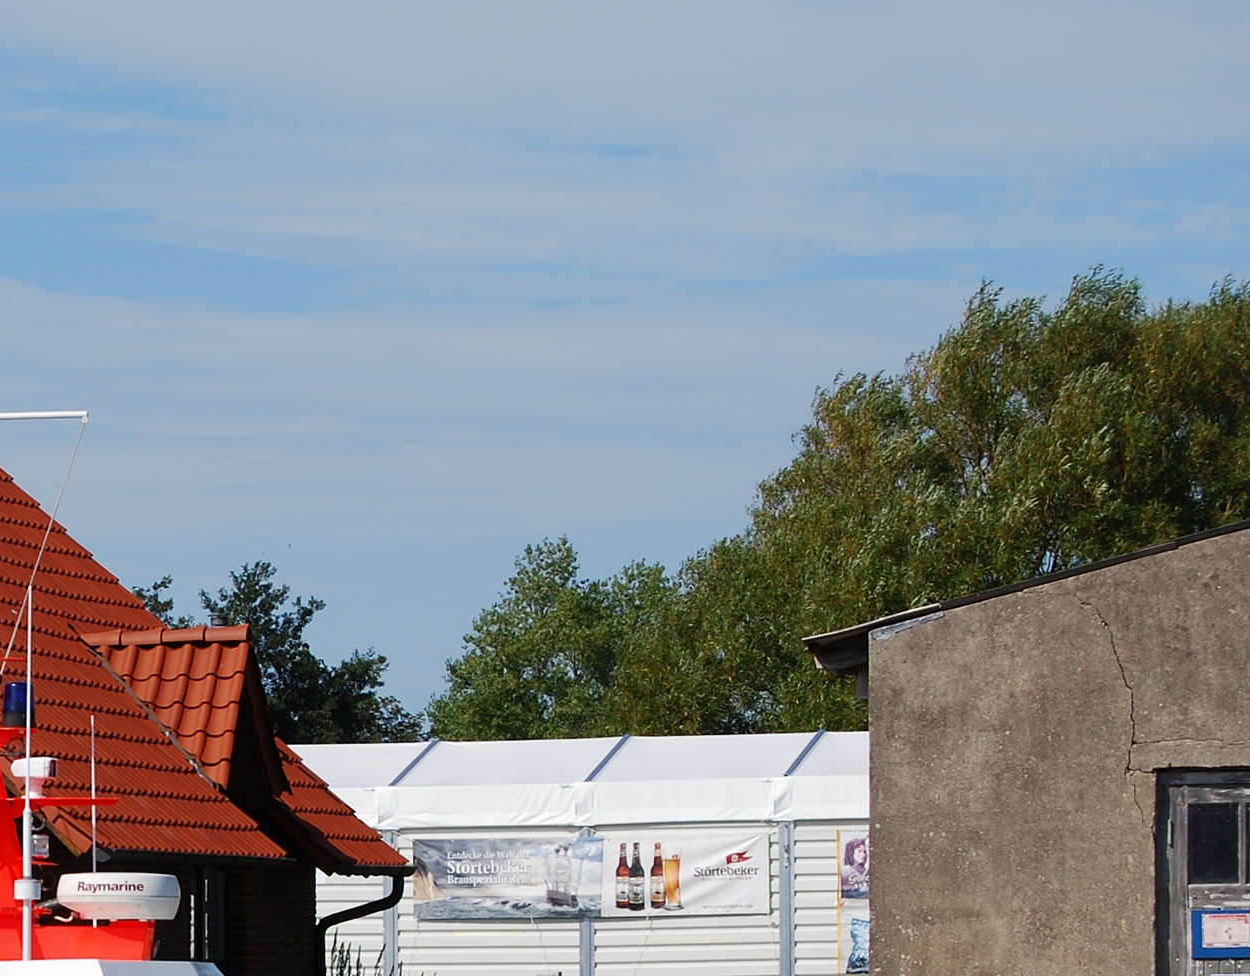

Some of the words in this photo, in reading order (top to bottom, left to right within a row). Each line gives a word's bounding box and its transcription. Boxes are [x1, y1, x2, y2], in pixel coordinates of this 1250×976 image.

[447, 851, 482, 860] Entdecke
[483, 850, 496, 859] die
[496, 850, 515, 859] Welt
[447, 860, 530, 874] Störtebeker
[693, 866, 760, 877] Störtebeker
[77, 881, 145, 893] Raymarine
